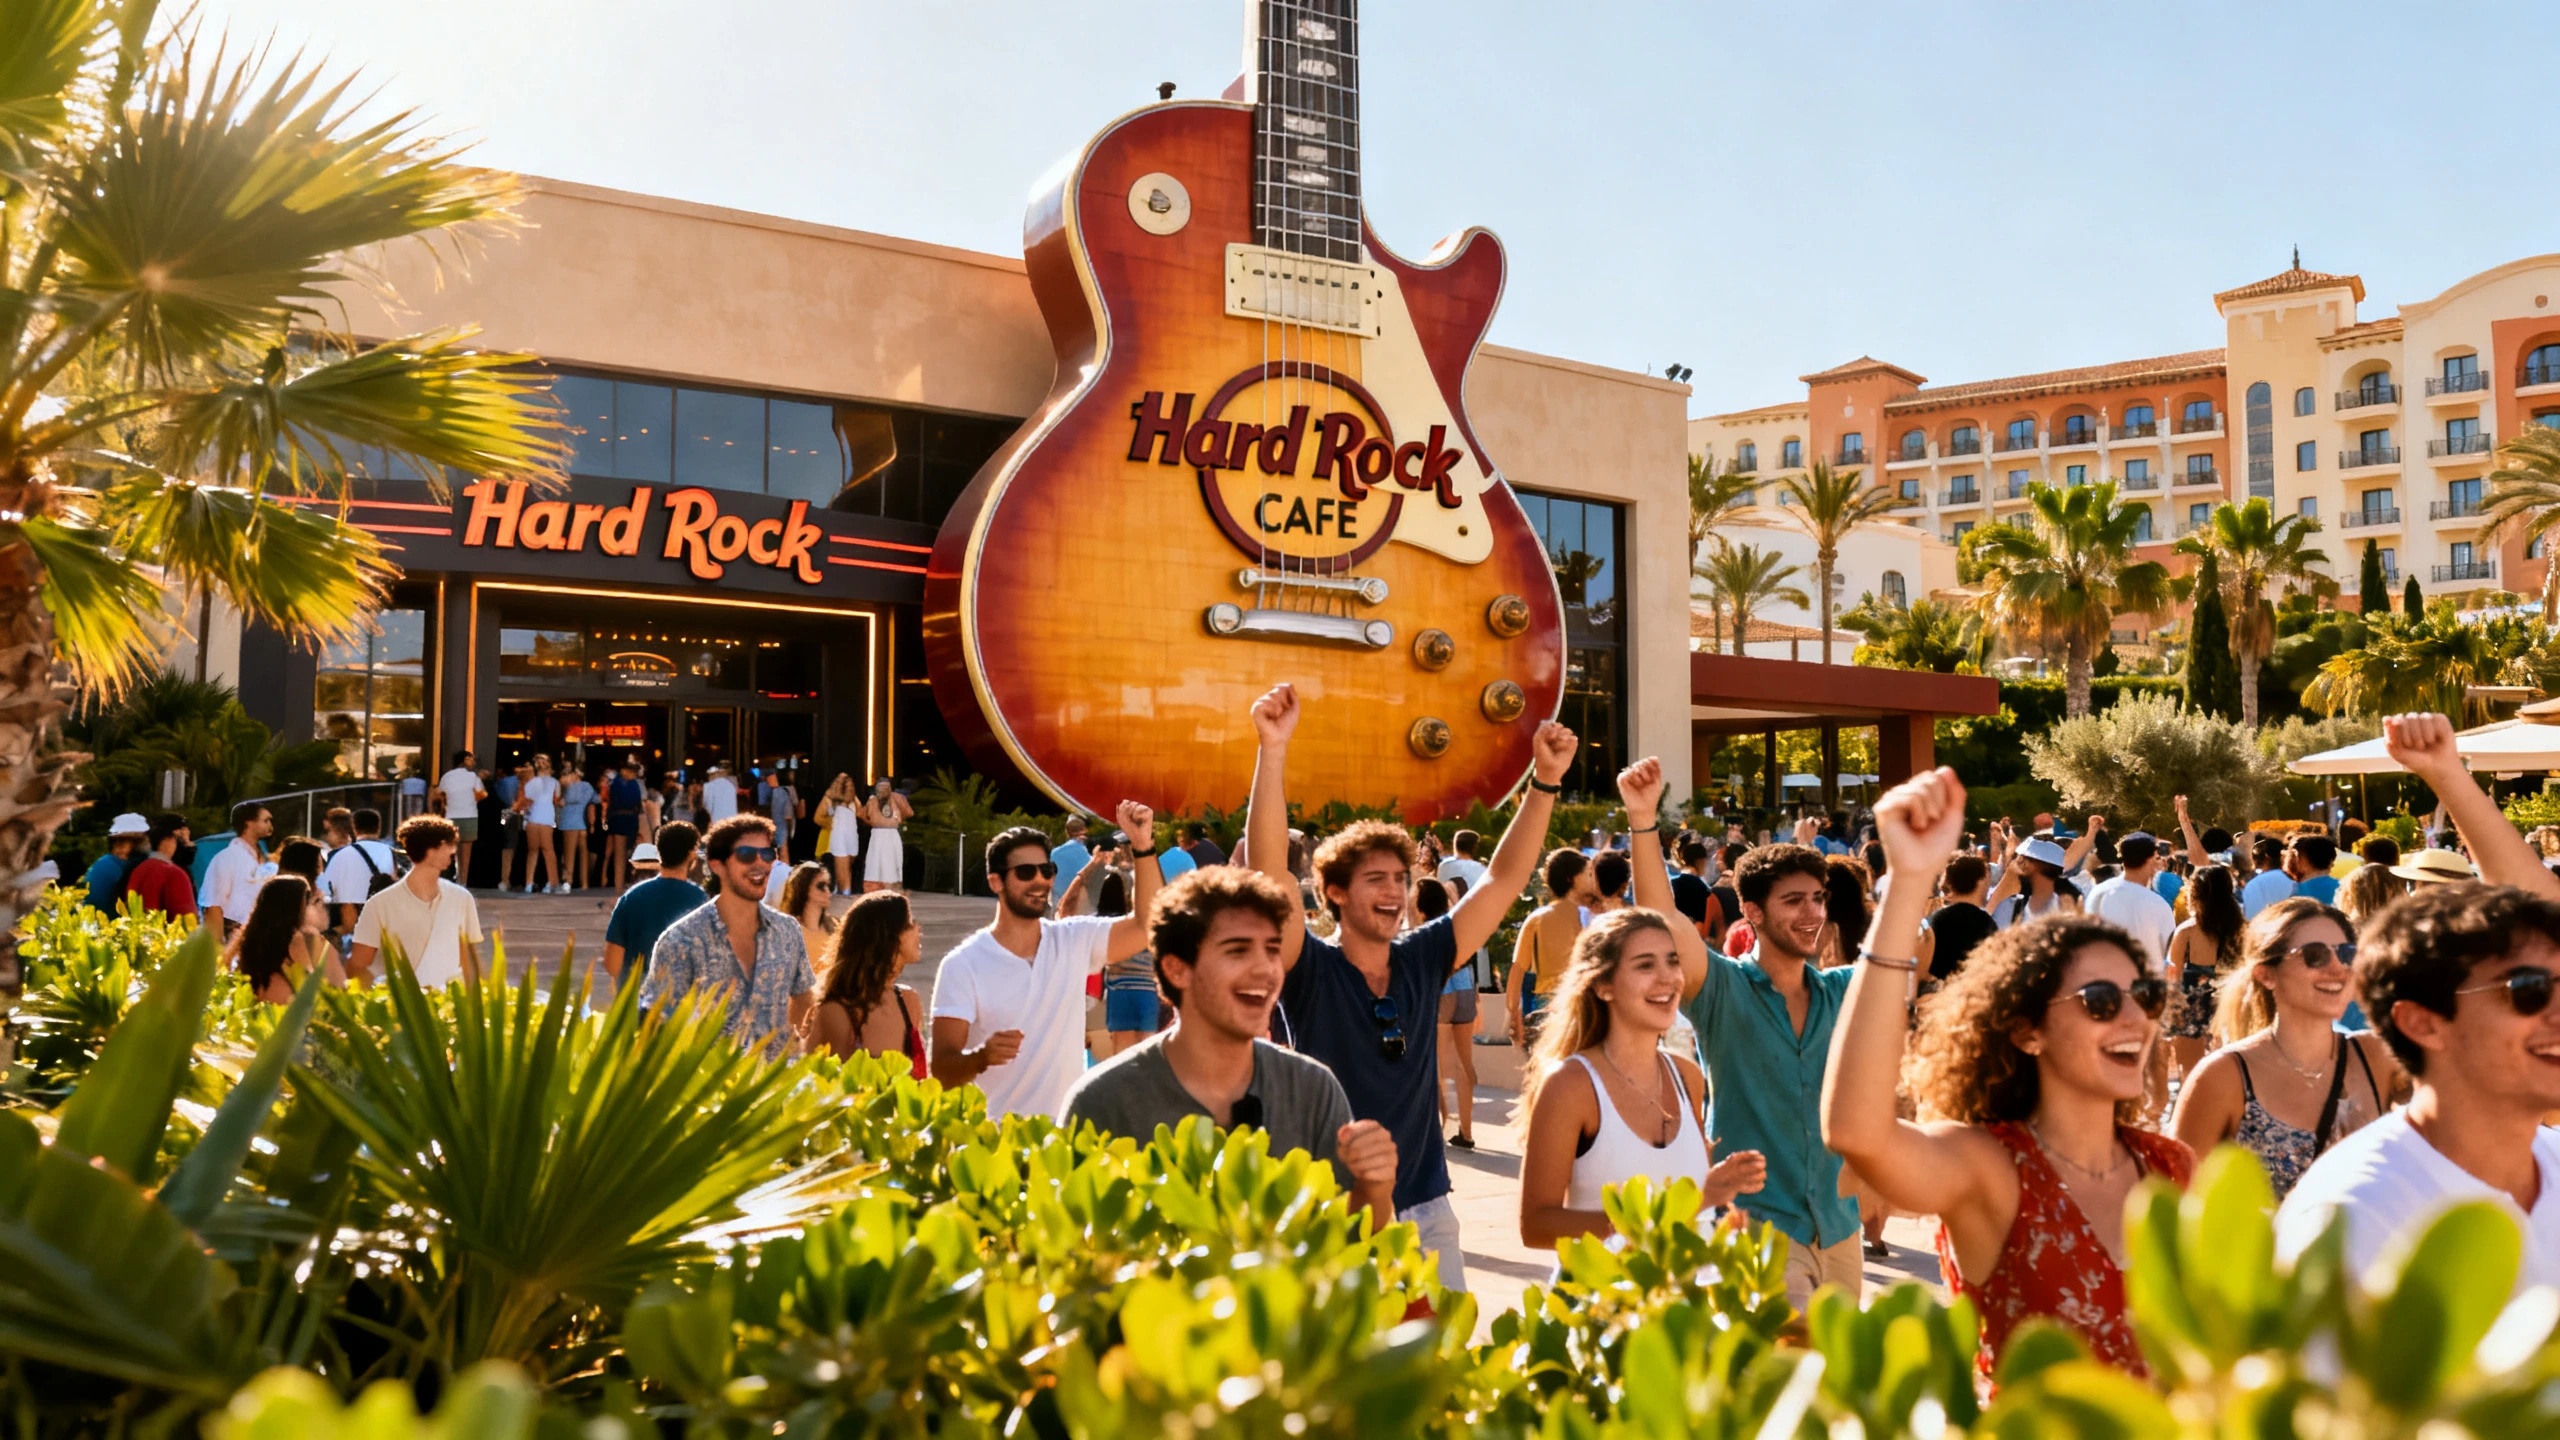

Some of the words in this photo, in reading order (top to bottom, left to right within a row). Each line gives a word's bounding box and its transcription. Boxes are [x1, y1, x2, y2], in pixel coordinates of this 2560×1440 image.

[1127, 391, 1310, 477] Hard
[1314, 412, 1463, 509] Rock
[462, 479, 653, 557] Hard
[663, 487, 824, 584] Rock
[1255, 493, 1358, 539] CAFE
